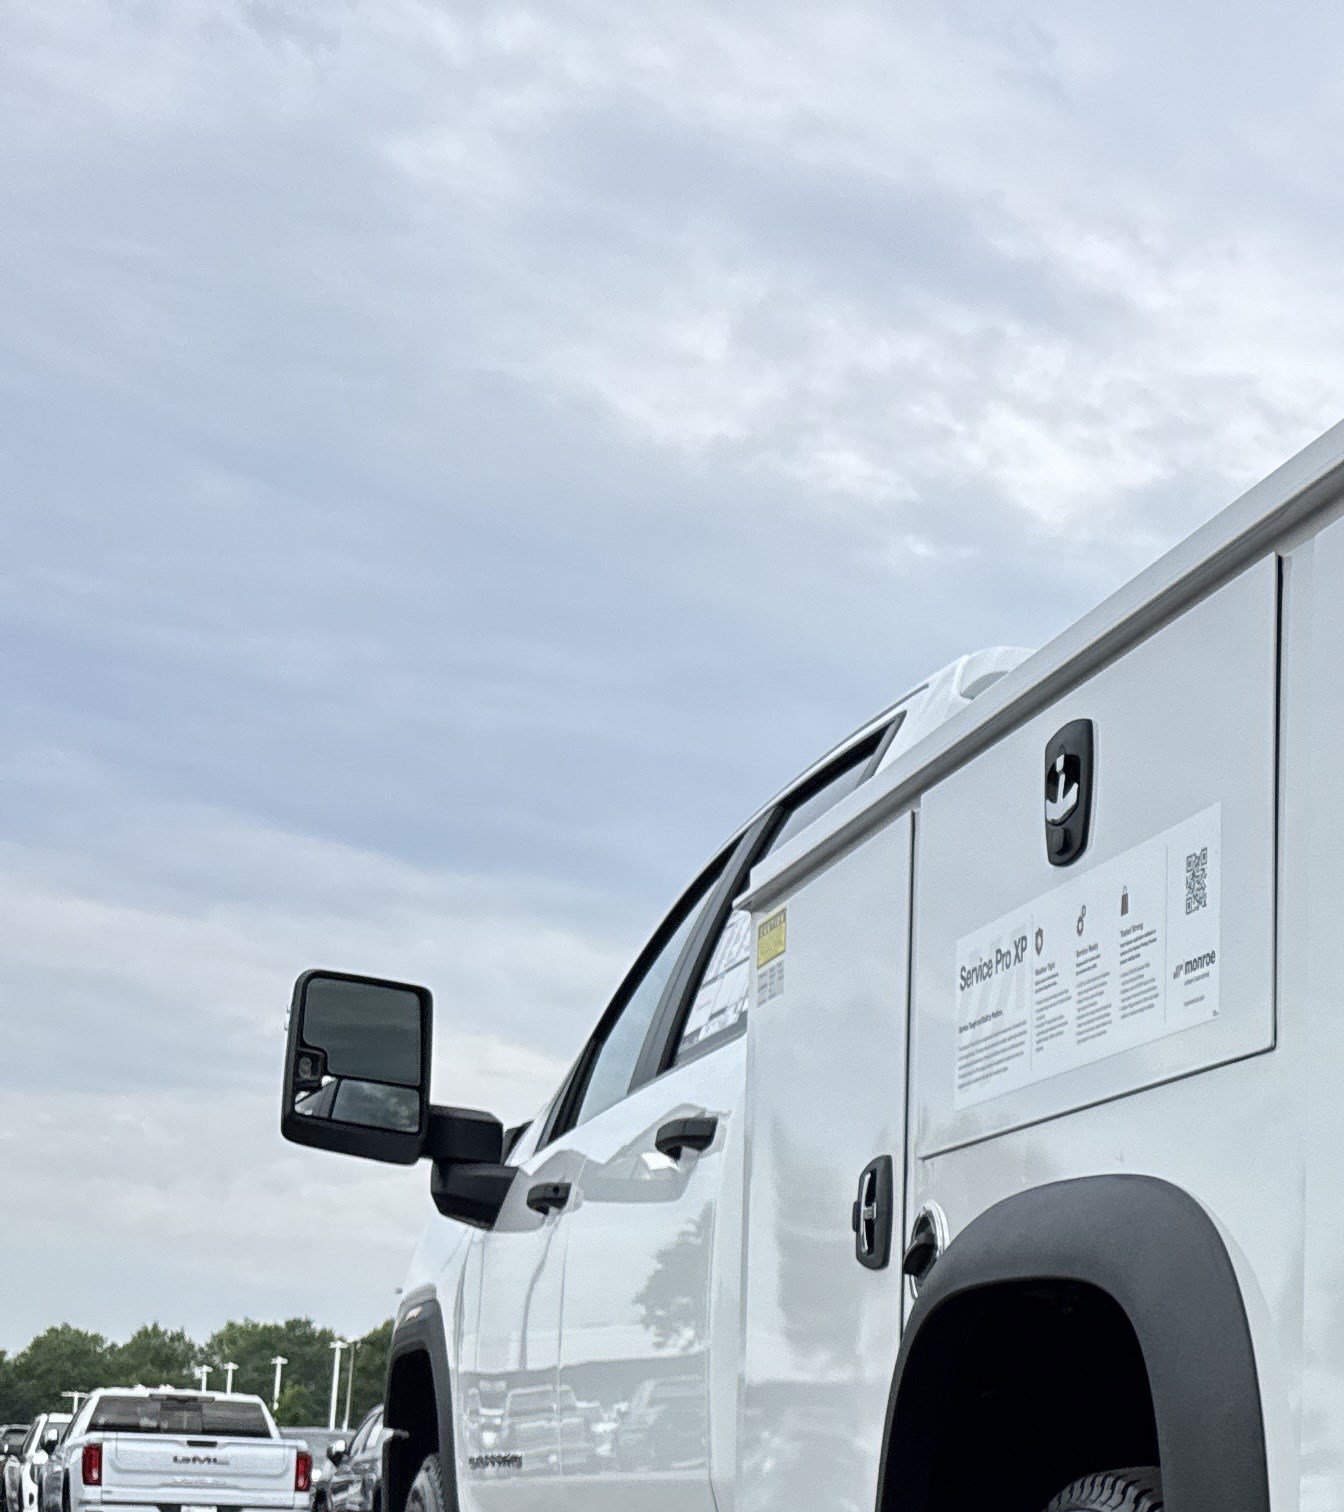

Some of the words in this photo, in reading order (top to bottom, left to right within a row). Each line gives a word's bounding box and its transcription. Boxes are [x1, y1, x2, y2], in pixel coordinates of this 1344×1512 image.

[960, 957, 993, 991] Service
[995, 948, 1011, 975] Pro
[1013, 935, 1027, 966] XP
[1185, 950, 1216, 975] monroe
